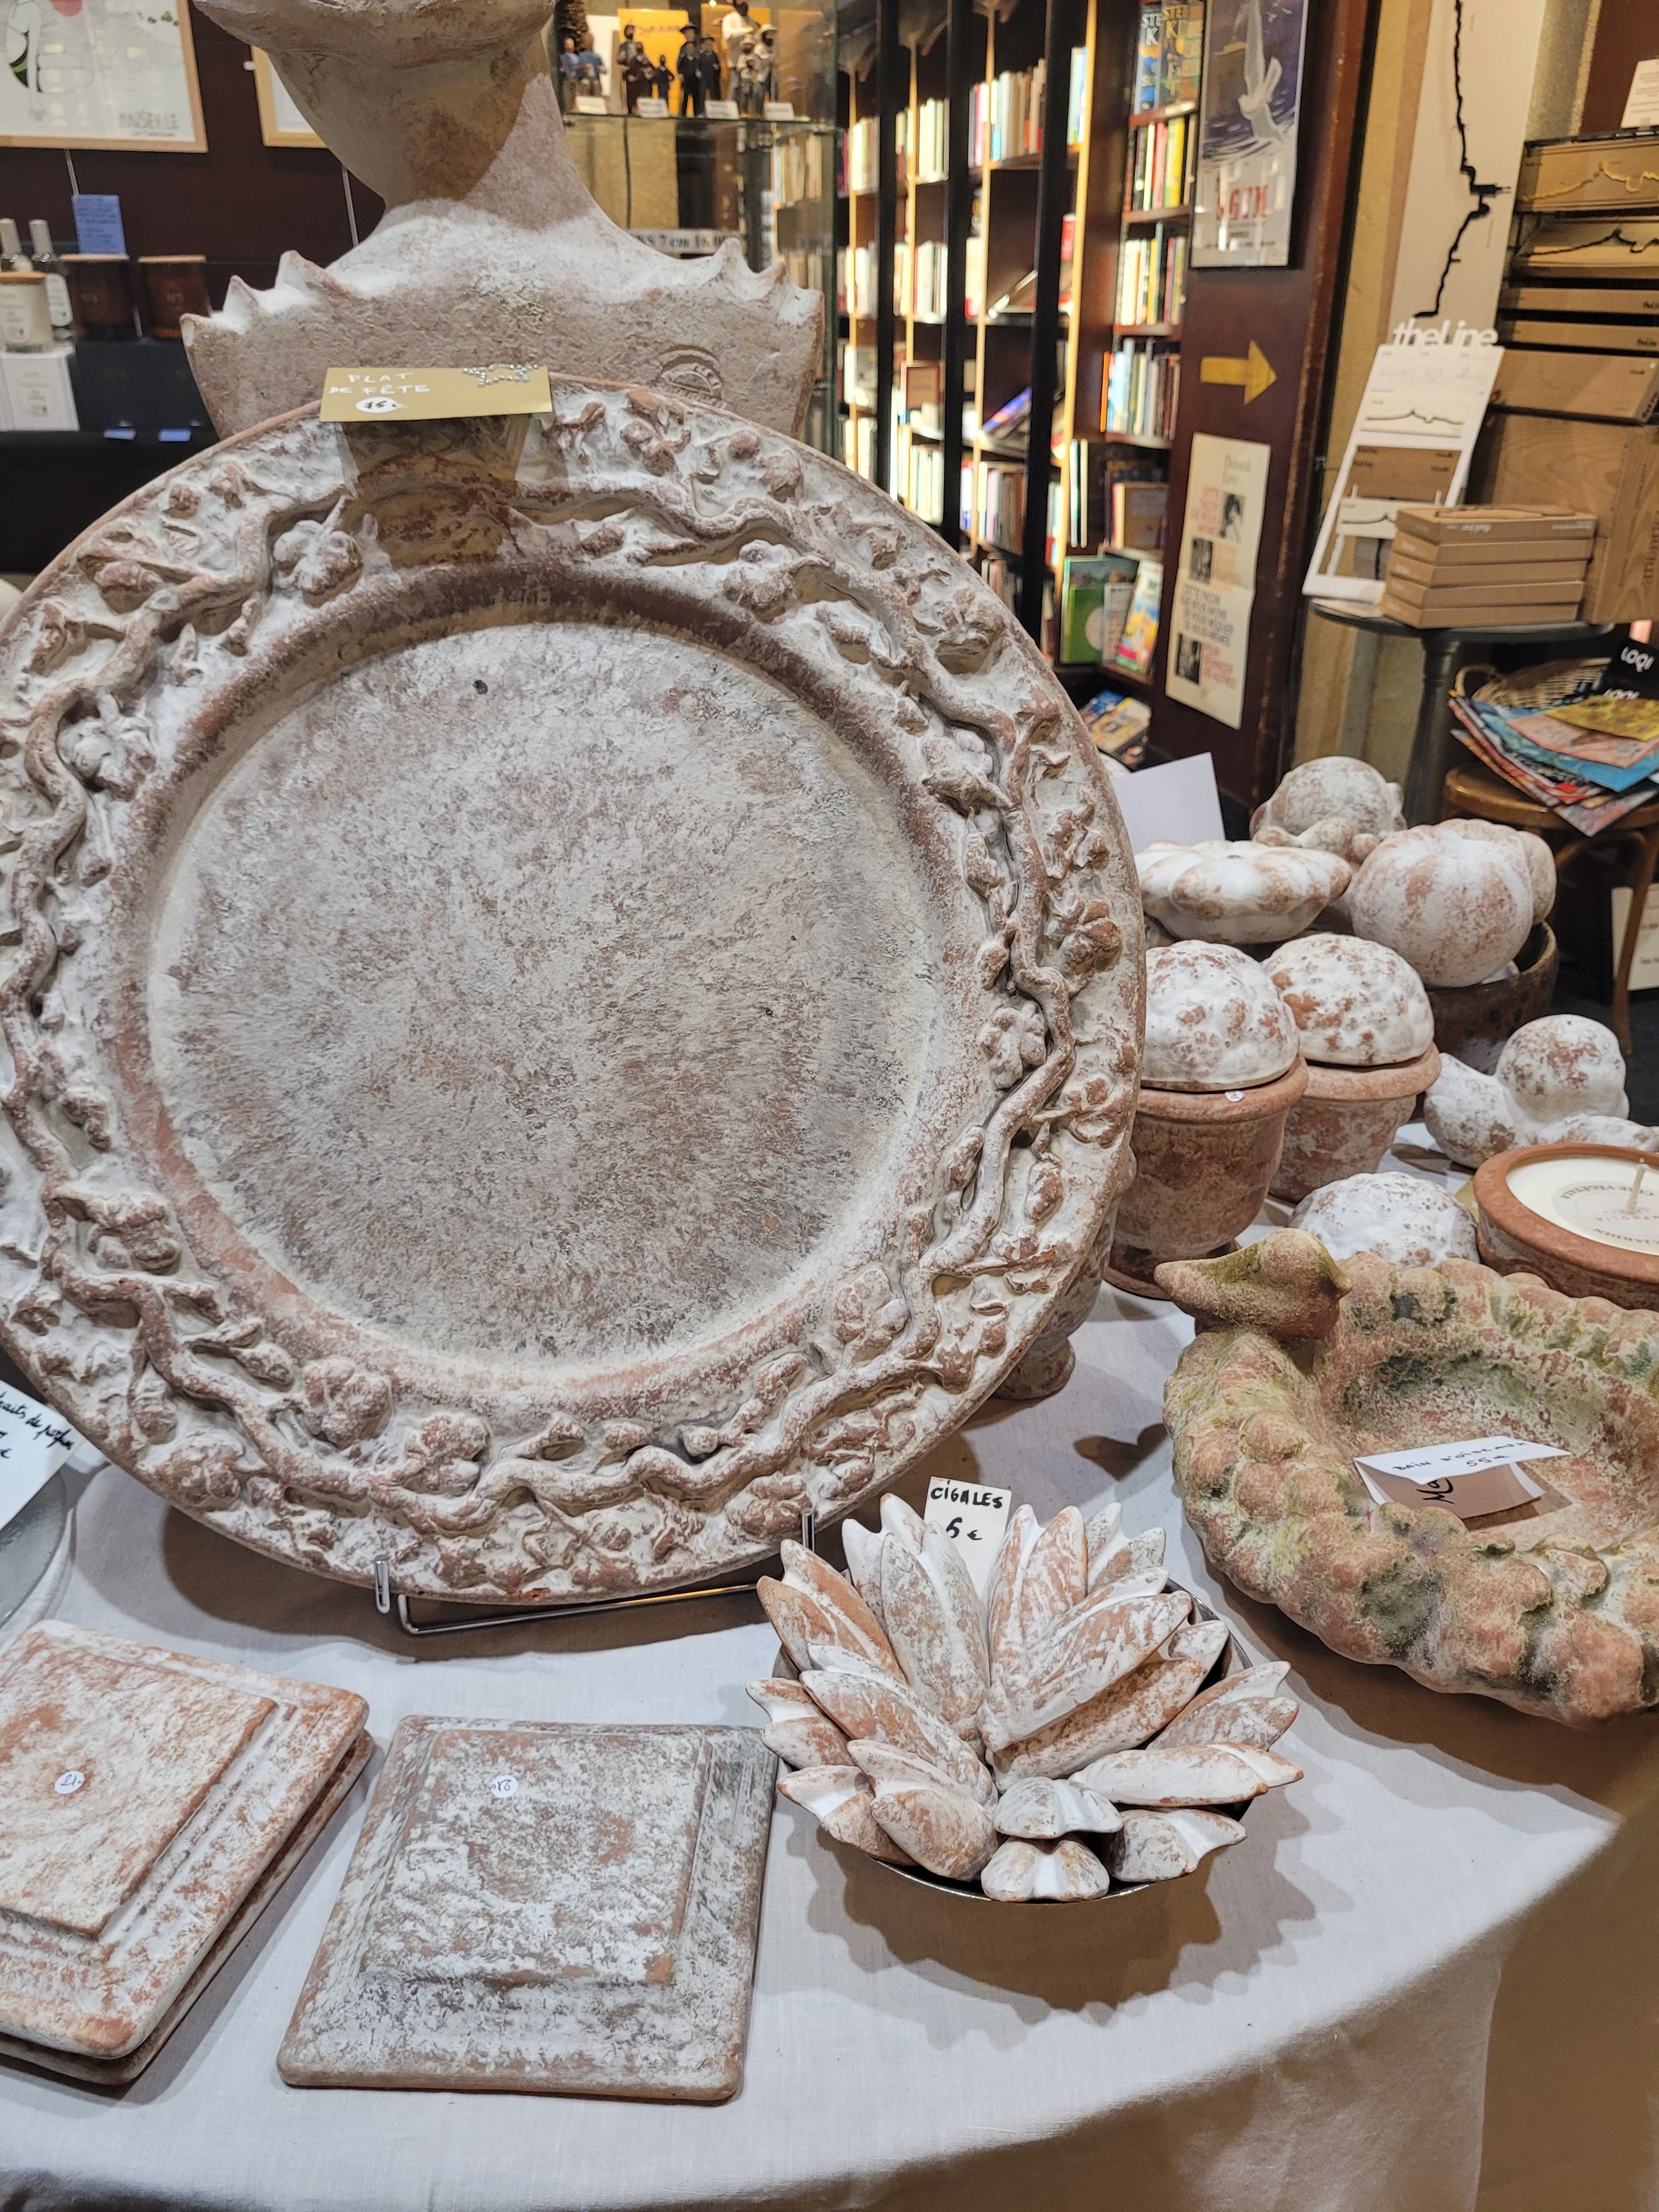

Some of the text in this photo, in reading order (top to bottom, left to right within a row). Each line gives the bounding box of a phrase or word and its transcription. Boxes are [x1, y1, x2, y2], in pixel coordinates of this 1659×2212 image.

[347, 372, 414, 383] PLAT
[329, 385, 354, 394] DE
[25, 1413, 43, 1428] de
[1392, 1460, 1431, 1471] BAIN
[930, 1480, 1003, 1509] CIGALES
